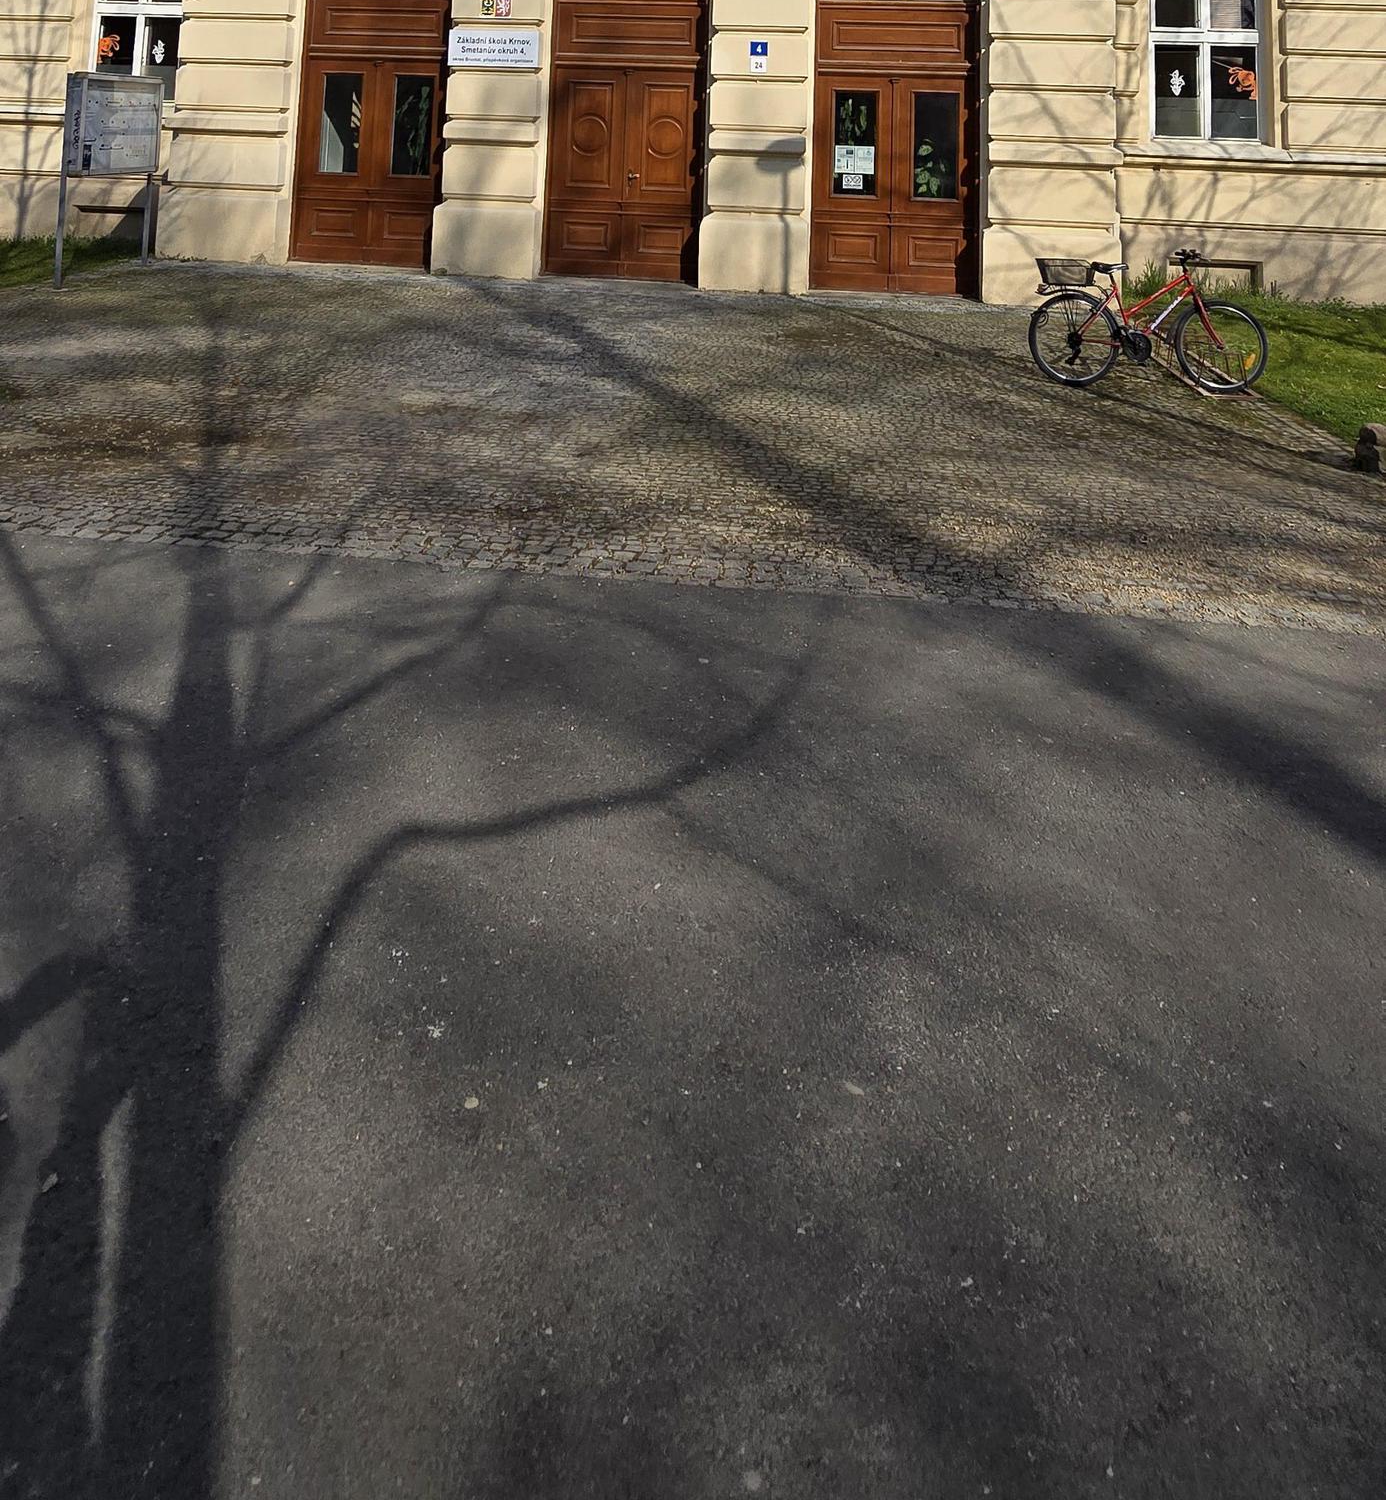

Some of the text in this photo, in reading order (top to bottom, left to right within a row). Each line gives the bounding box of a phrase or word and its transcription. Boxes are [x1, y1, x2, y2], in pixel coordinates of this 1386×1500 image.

[457, 36, 532, 47] Základní škola Krnov,
[497, 47, 518, 55] okruh
[519, 47, 527, 56] 4,
[757, 44, 762, 53] 4
